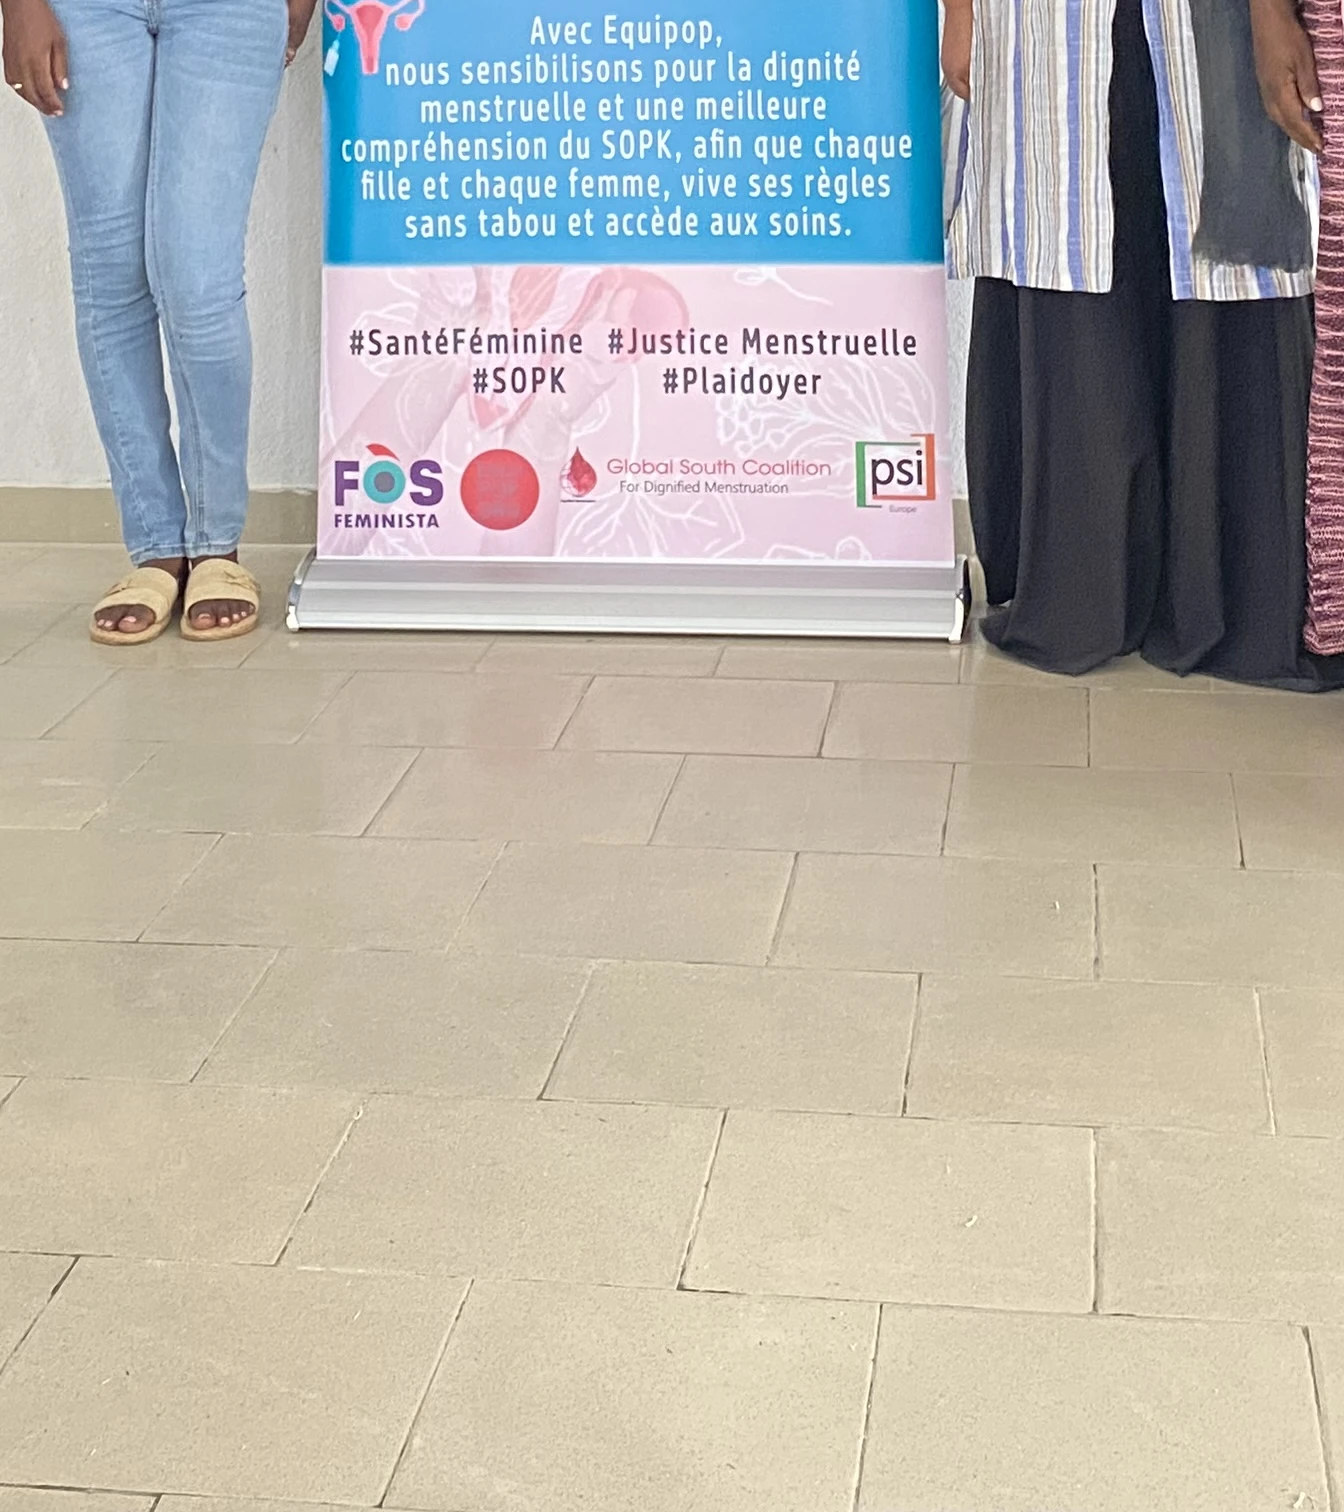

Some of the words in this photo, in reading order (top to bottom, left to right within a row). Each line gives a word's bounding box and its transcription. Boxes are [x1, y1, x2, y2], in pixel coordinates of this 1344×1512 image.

[530, 15, 592, 46] Avec
[604, 14, 723, 50] Equipop,
[385, 61, 450, 86] nous
[461, 53, 643, 84] sensibilisons
[654, 57, 716, 88] pour
[727, 50, 752, 82] la
[763, 49, 861, 88] dignité
[420, 90, 586, 124] menstruelle
[598, 93, 625, 121] et
[636, 96, 684, 121] une
[696, 89, 827, 120] meilleure
[341, 130, 547, 168] compréhension
[559, 128, 590, 160] du
[602, 128, 682, 164] SOPK,
[693, 128, 742, 159] afin
[754, 134, 803, 165] que
[814, 128, 913, 165] chaque
[361, 169, 411, 201] fille
[423, 172, 450, 200] et
[461, 168, 557, 205] chaque
[568, 167, 670, 202] femme,
[682, 167, 737, 198] vive
[748, 173, 793, 198] ses
[805, 166, 891, 205] règles
[405, 213, 467, 239] sans
[478, 206, 556, 238] tabou
[567, 208, 594, 237] et
[606, 205, 699, 237] accède
[710, 211, 758, 236] aux
[769, 205, 852, 236] soins.
[349, 327, 583, 356] #SantéFéminine
[608, 327, 729, 355] #Justice
[742, 327, 918, 356] Menstruelle
[473, 366, 566, 394] #SOPK
[662, 366, 822, 400] #Plaidoyer
[607, 458, 673, 475] Global
[679, 458, 736, 476] South
[742, 458, 831, 477] Coalition
[871, 449, 923, 496] psi
[619, 480, 641, 493] For
[644, 480, 700, 497] Dignified
[705, 481, 789, 494] Menstruation
[334, 513, 440, 529] FEMINISTA
[889, 504, 917, 513] Europe
